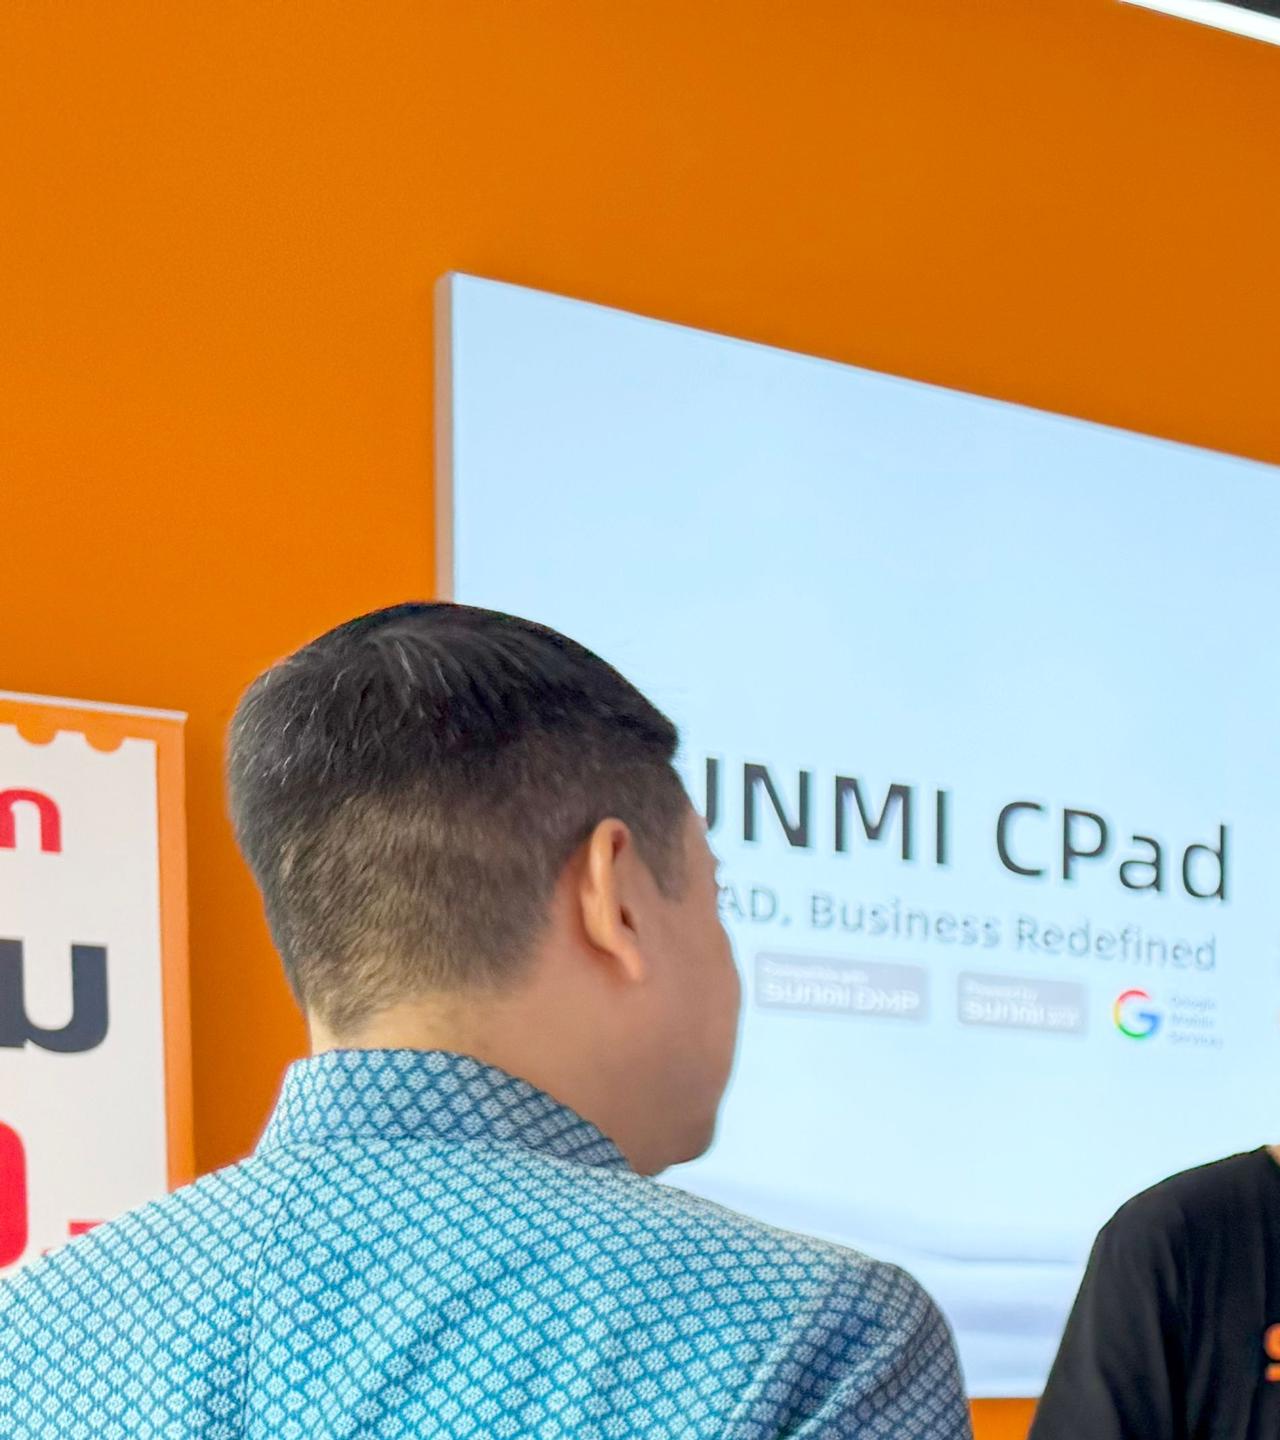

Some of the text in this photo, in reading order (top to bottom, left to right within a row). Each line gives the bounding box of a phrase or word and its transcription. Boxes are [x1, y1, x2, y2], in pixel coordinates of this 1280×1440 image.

[995, 801, 1231, 904] CPad
[810, 893, 1001, 949] Business
[1016, 916, 1217, 972] Redefined
